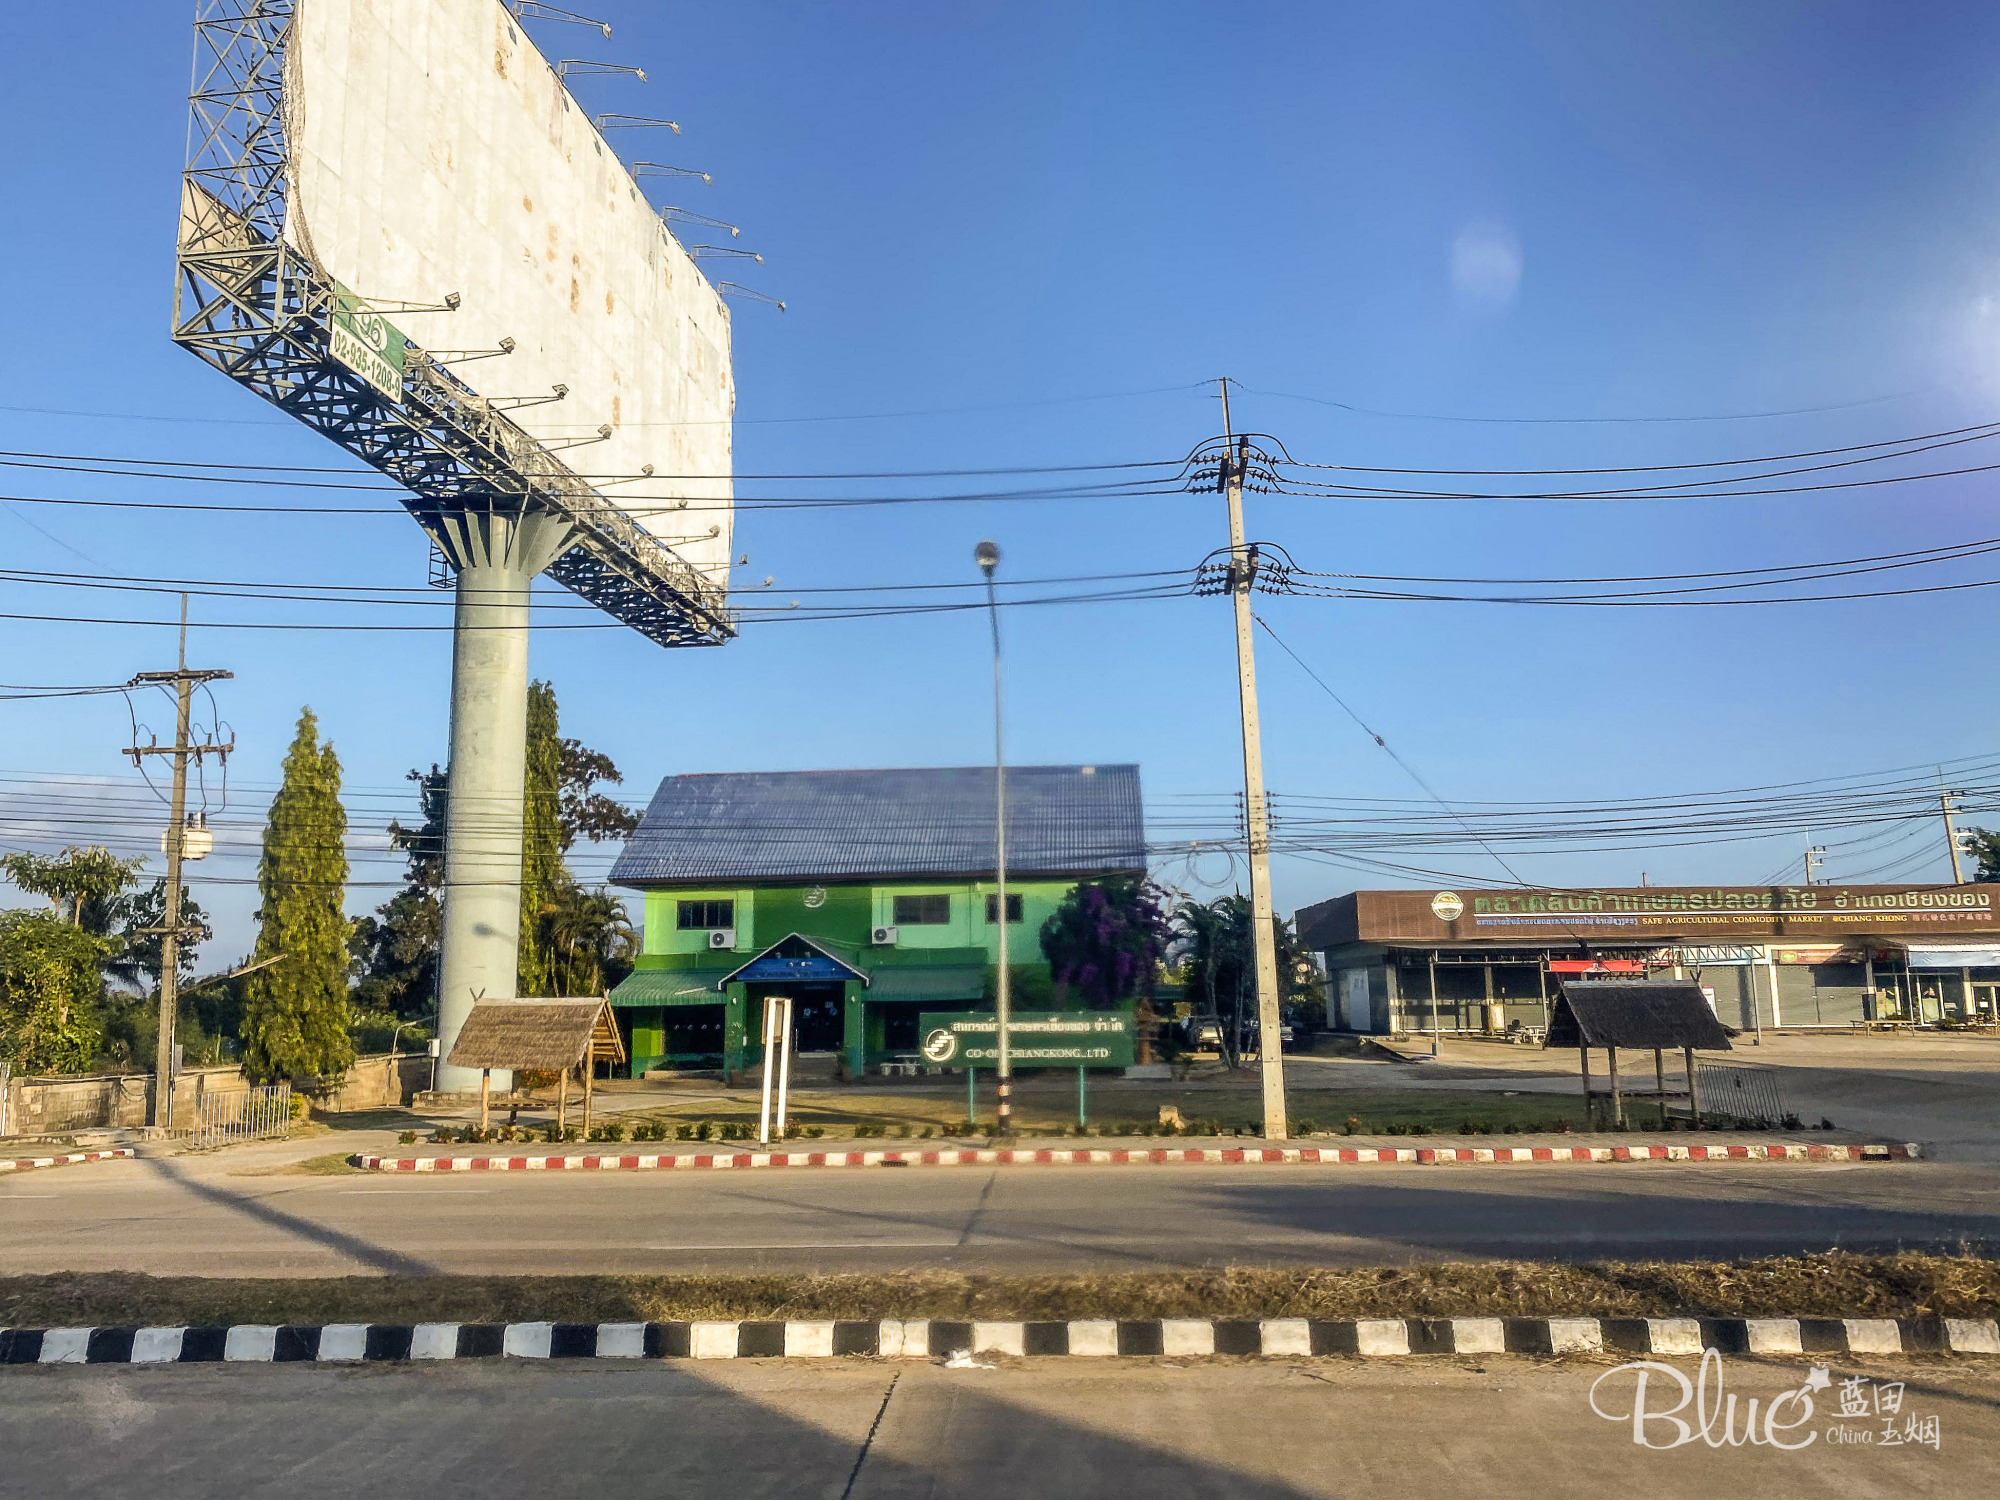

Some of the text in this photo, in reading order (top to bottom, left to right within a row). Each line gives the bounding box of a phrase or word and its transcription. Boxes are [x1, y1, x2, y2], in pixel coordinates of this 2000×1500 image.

[334, 330, 401, 398] 02-935-1208-9
[1642, 917, 1663, 925] SAFE
[1666, 916, 1730, 925] AGRICULTURAL
[1789, 914, 1824, 923] MARKET
